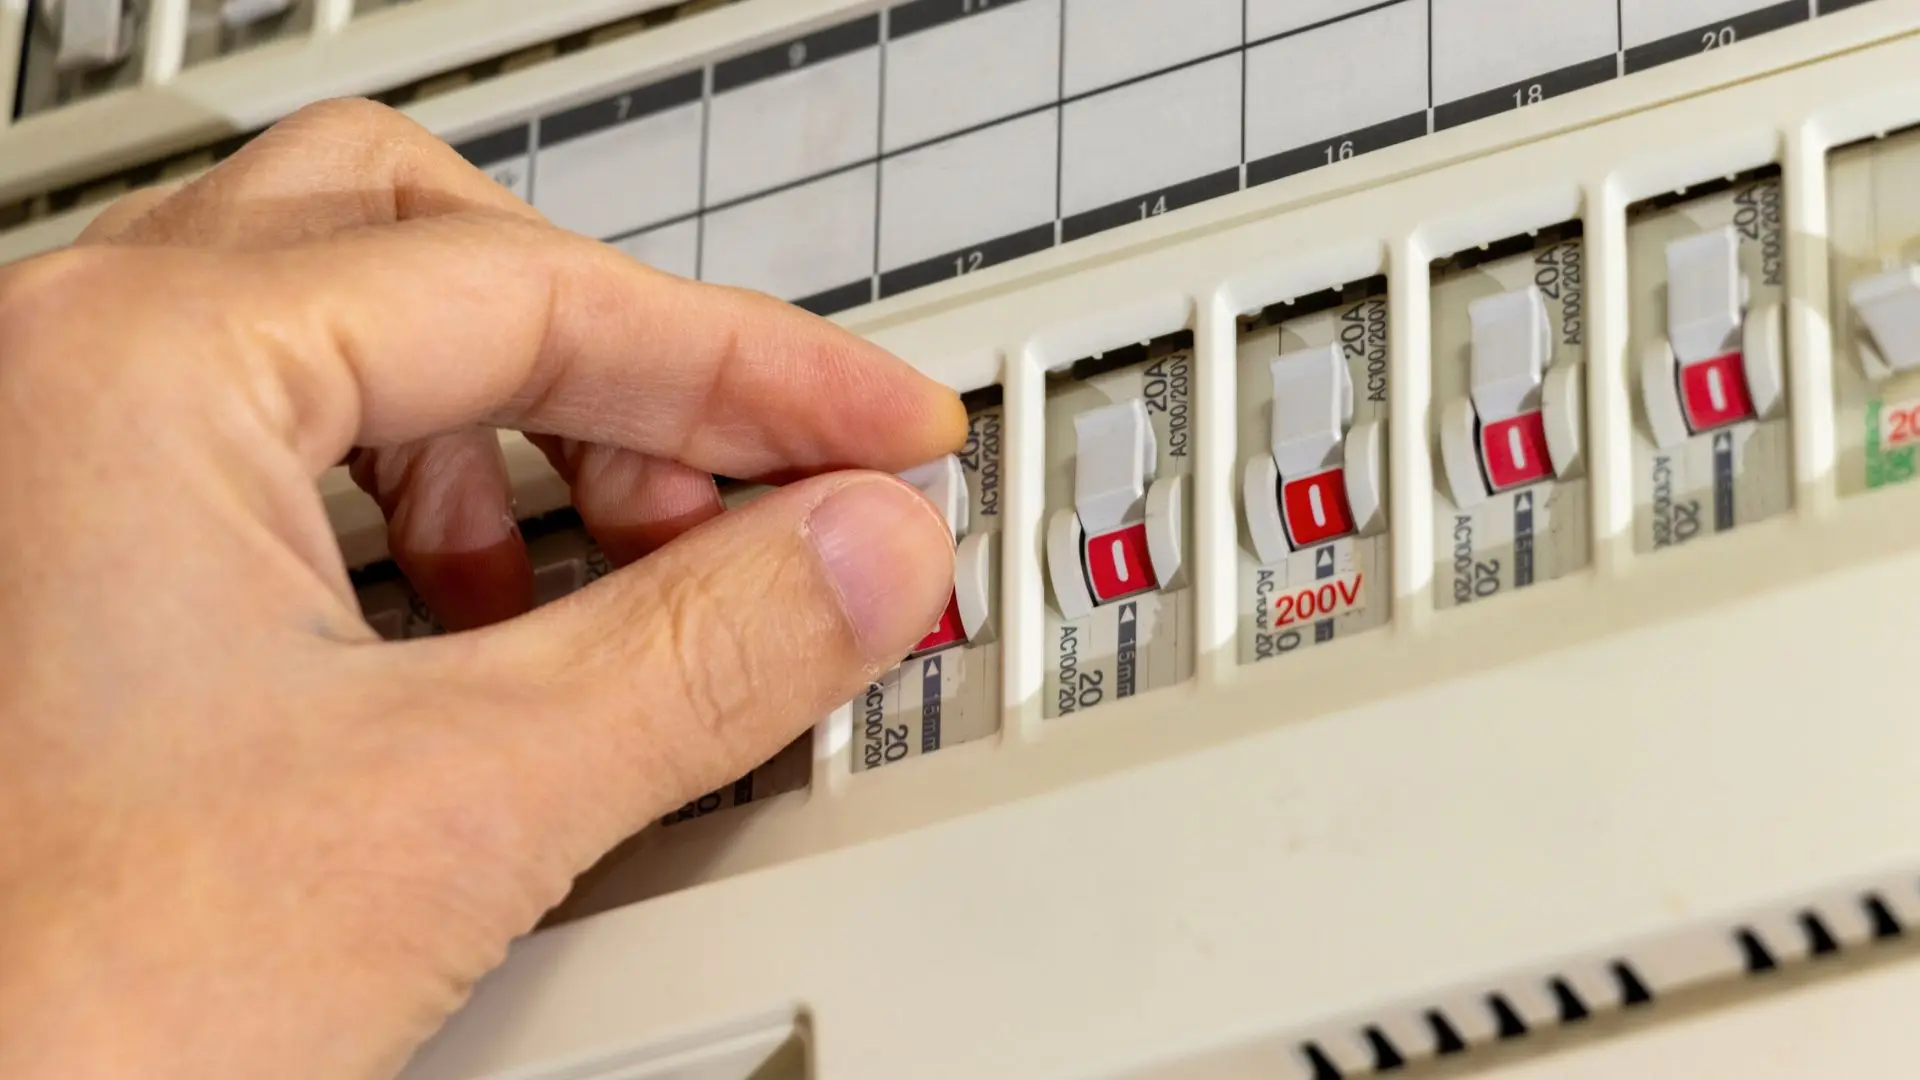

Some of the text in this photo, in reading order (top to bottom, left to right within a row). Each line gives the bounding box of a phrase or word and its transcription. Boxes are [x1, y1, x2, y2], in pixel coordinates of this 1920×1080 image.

[788, 41, 807, 69] 9
[1702, 26, 1735, 52] 20
[614, 94, 633, 121] 7
[1512, 84, 1542, 109] 18
[1324, 140, 1354, 165] 16
[1138, 196, 1167, 220] 14
[954, 252, 983, 277] 12
[1535, 245, 1559, 299] 20A
[1562, 242, 1581, 345] AC100/200V
[1341, 302, 1365, 359] 20A
[1367, 300, 1386, 402] AC100/200V
[1144, 358, 1168, 415] 20A
[1169, 355, 1188, 457] AC100/200V
[981, 413, 1000, 515] AC100/200V
[1675, 501, 1700, 541] 20
[1475, 559, 1499, 597] 20
[1275, 573, 1362, 627] 200V
[1079, 670, 1103, 707] 20
[885, 724, 908, 762] 20
